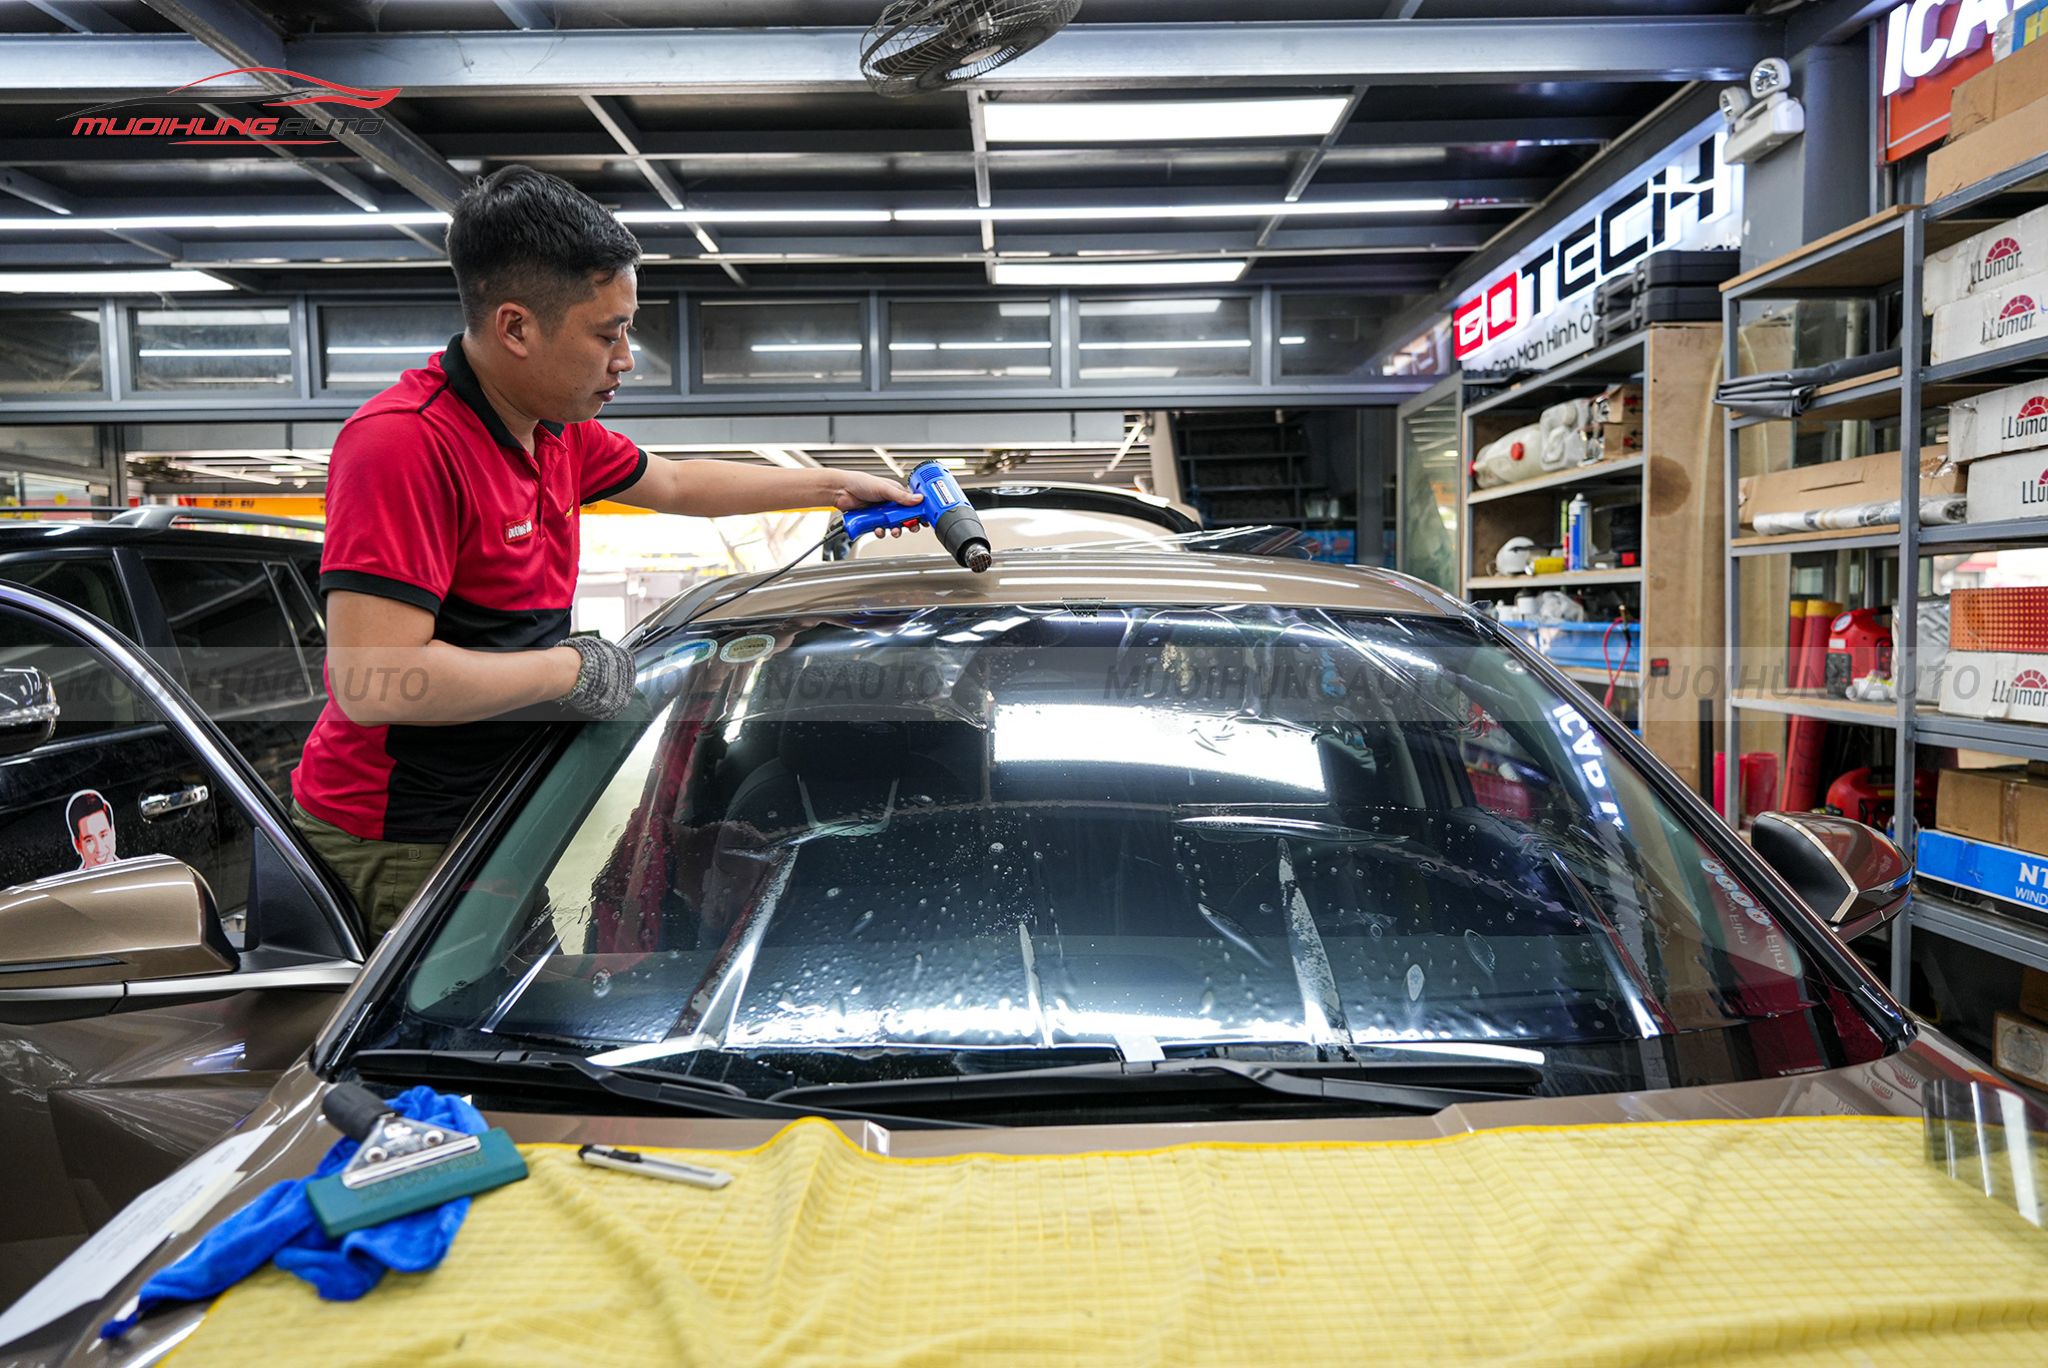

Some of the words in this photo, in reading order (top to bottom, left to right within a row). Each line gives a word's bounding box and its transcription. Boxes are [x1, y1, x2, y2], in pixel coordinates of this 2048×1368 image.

[1882, 0, 2020, 97] ICA
[1453, 133, 1724, 361] GOTECH
[2022, 480, 2048, 504] LLu
